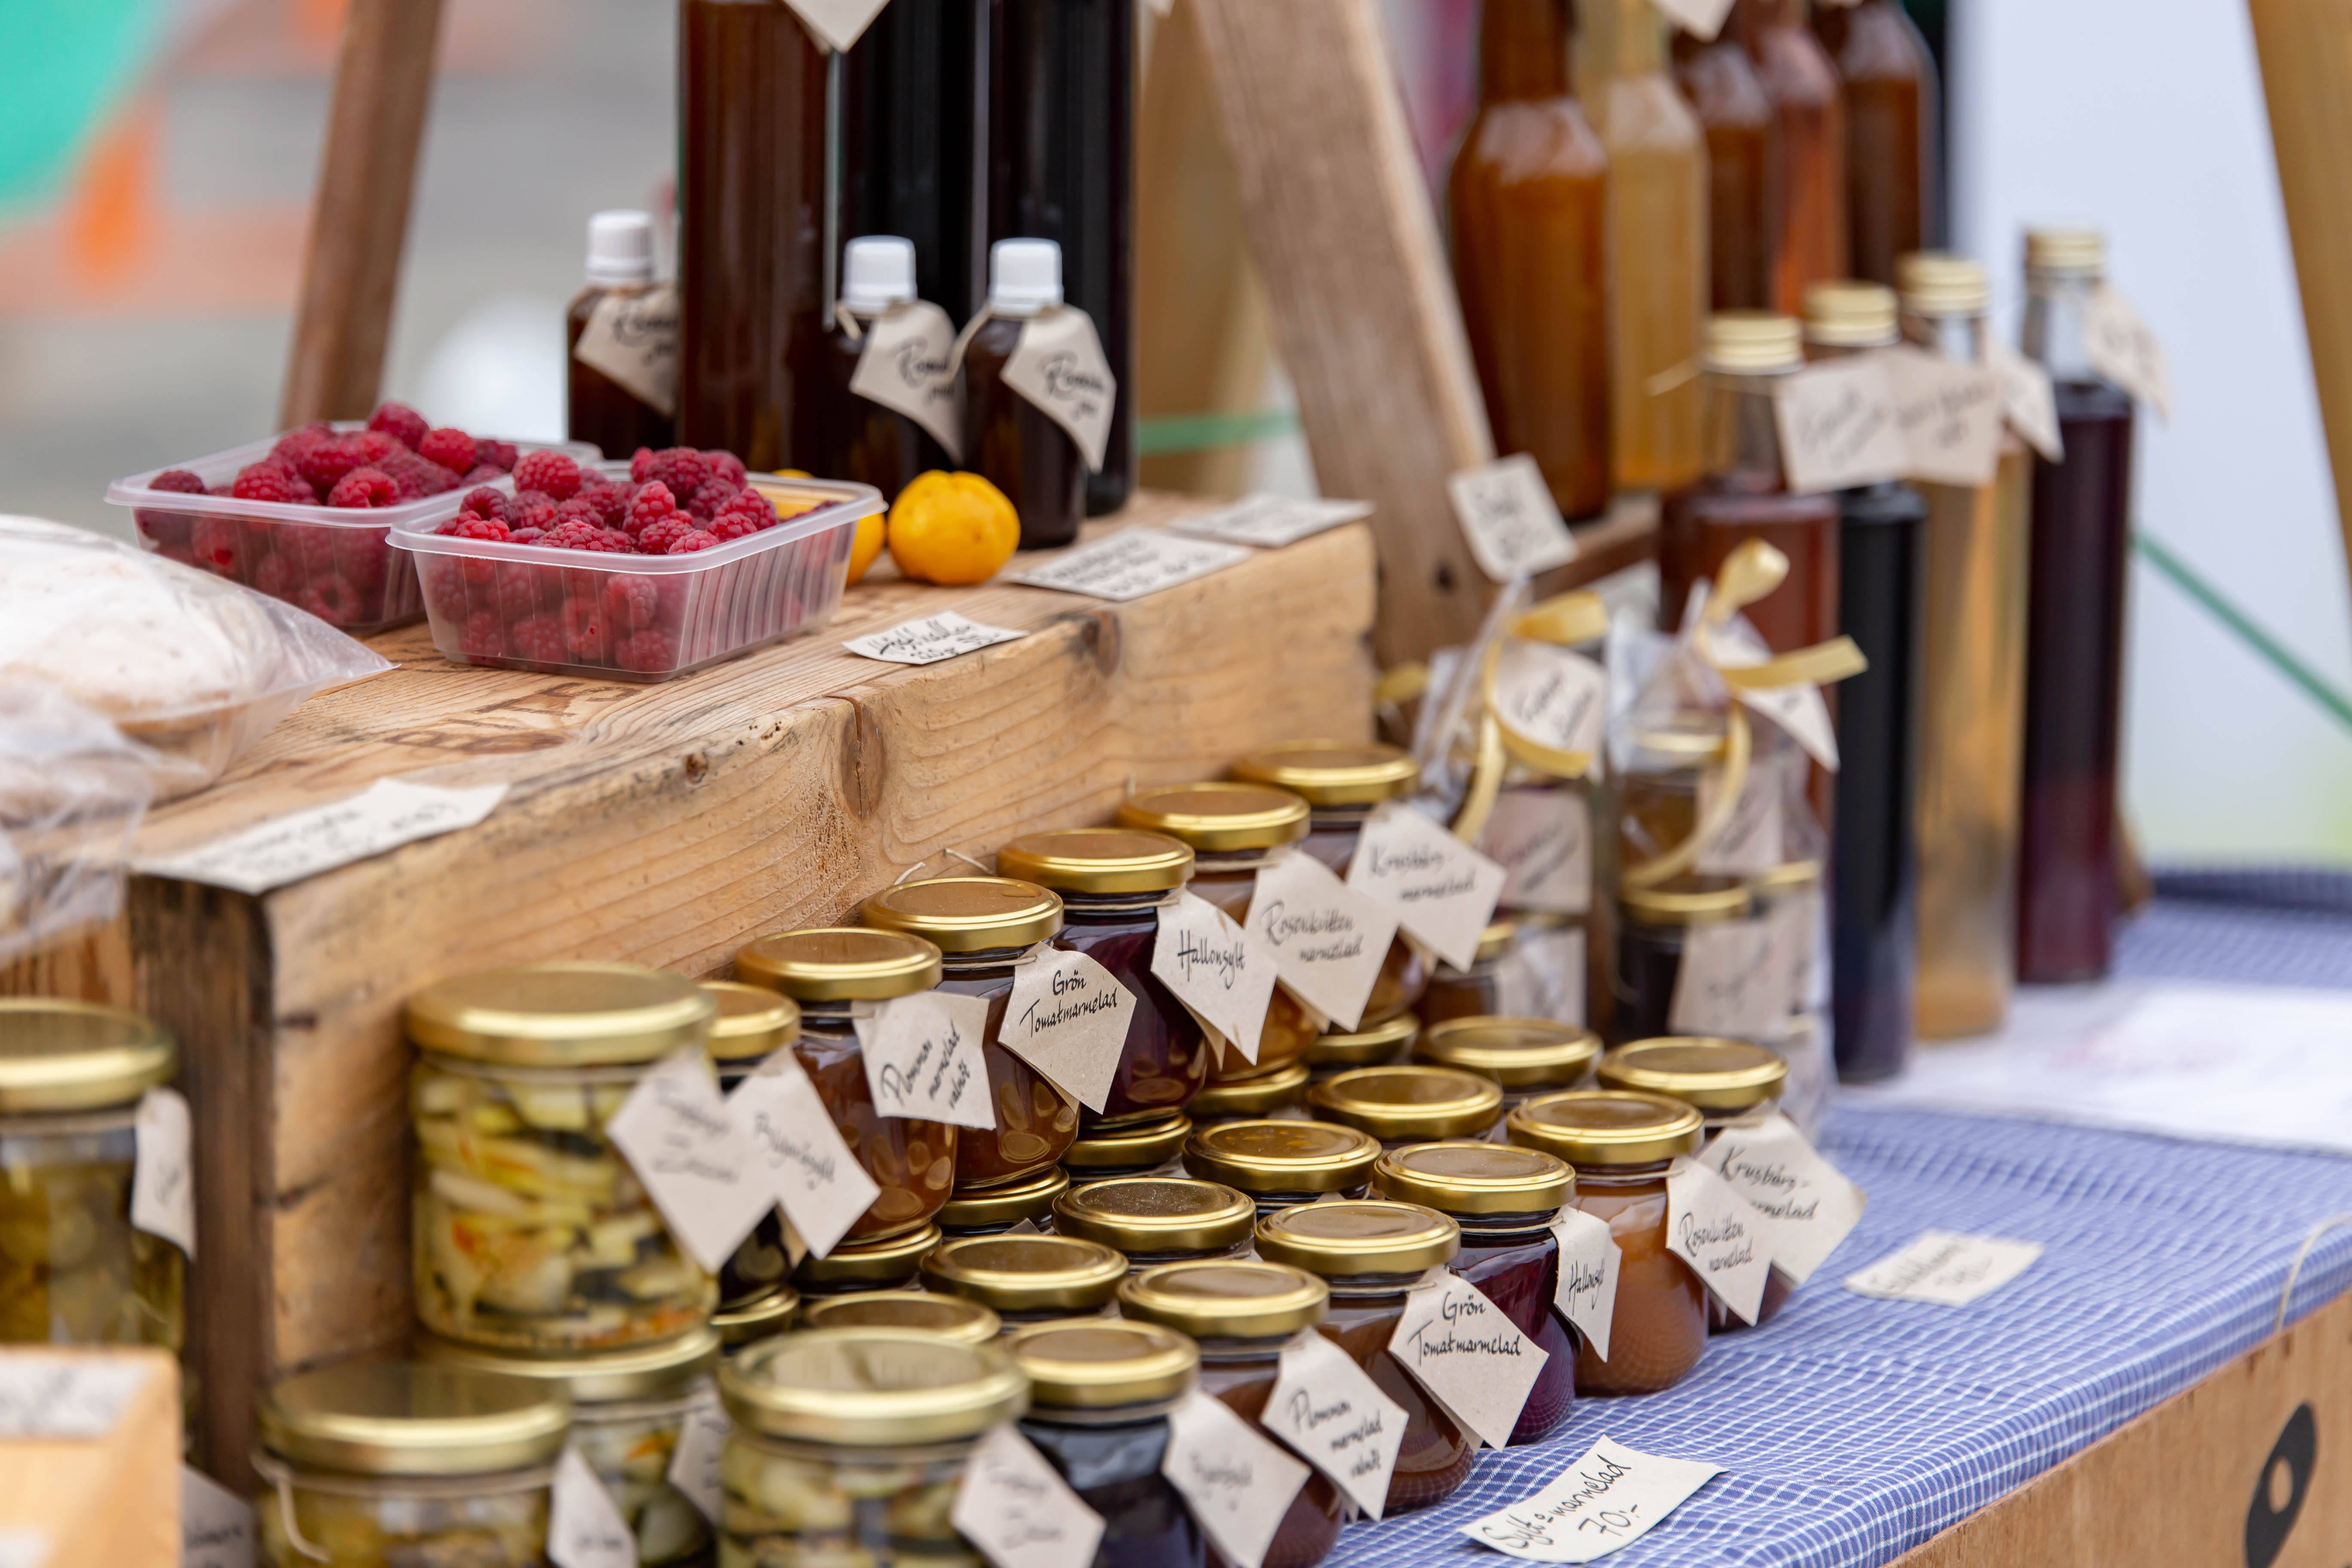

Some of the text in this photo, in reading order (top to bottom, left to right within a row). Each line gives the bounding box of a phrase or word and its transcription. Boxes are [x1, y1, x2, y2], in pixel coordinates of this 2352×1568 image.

[1177, 929, 1246, 990] Hallonsylt
[1053, 969, 1087, 995] Grön
[1020, 987, 1118, 1038] Tomatmarmelad
[1709, 1236, 1754, 1273] marmelad
[1442, 1291, 1486, 1327] Grön
[1408, 1319, 1522, 1367] Tomatmarmelad
[1482, 1514, 1554, 1549] Sylt
[1549, 1454, 1632, 1517] marmelad
[1578, 1504, 1640, 1537] 70:-
